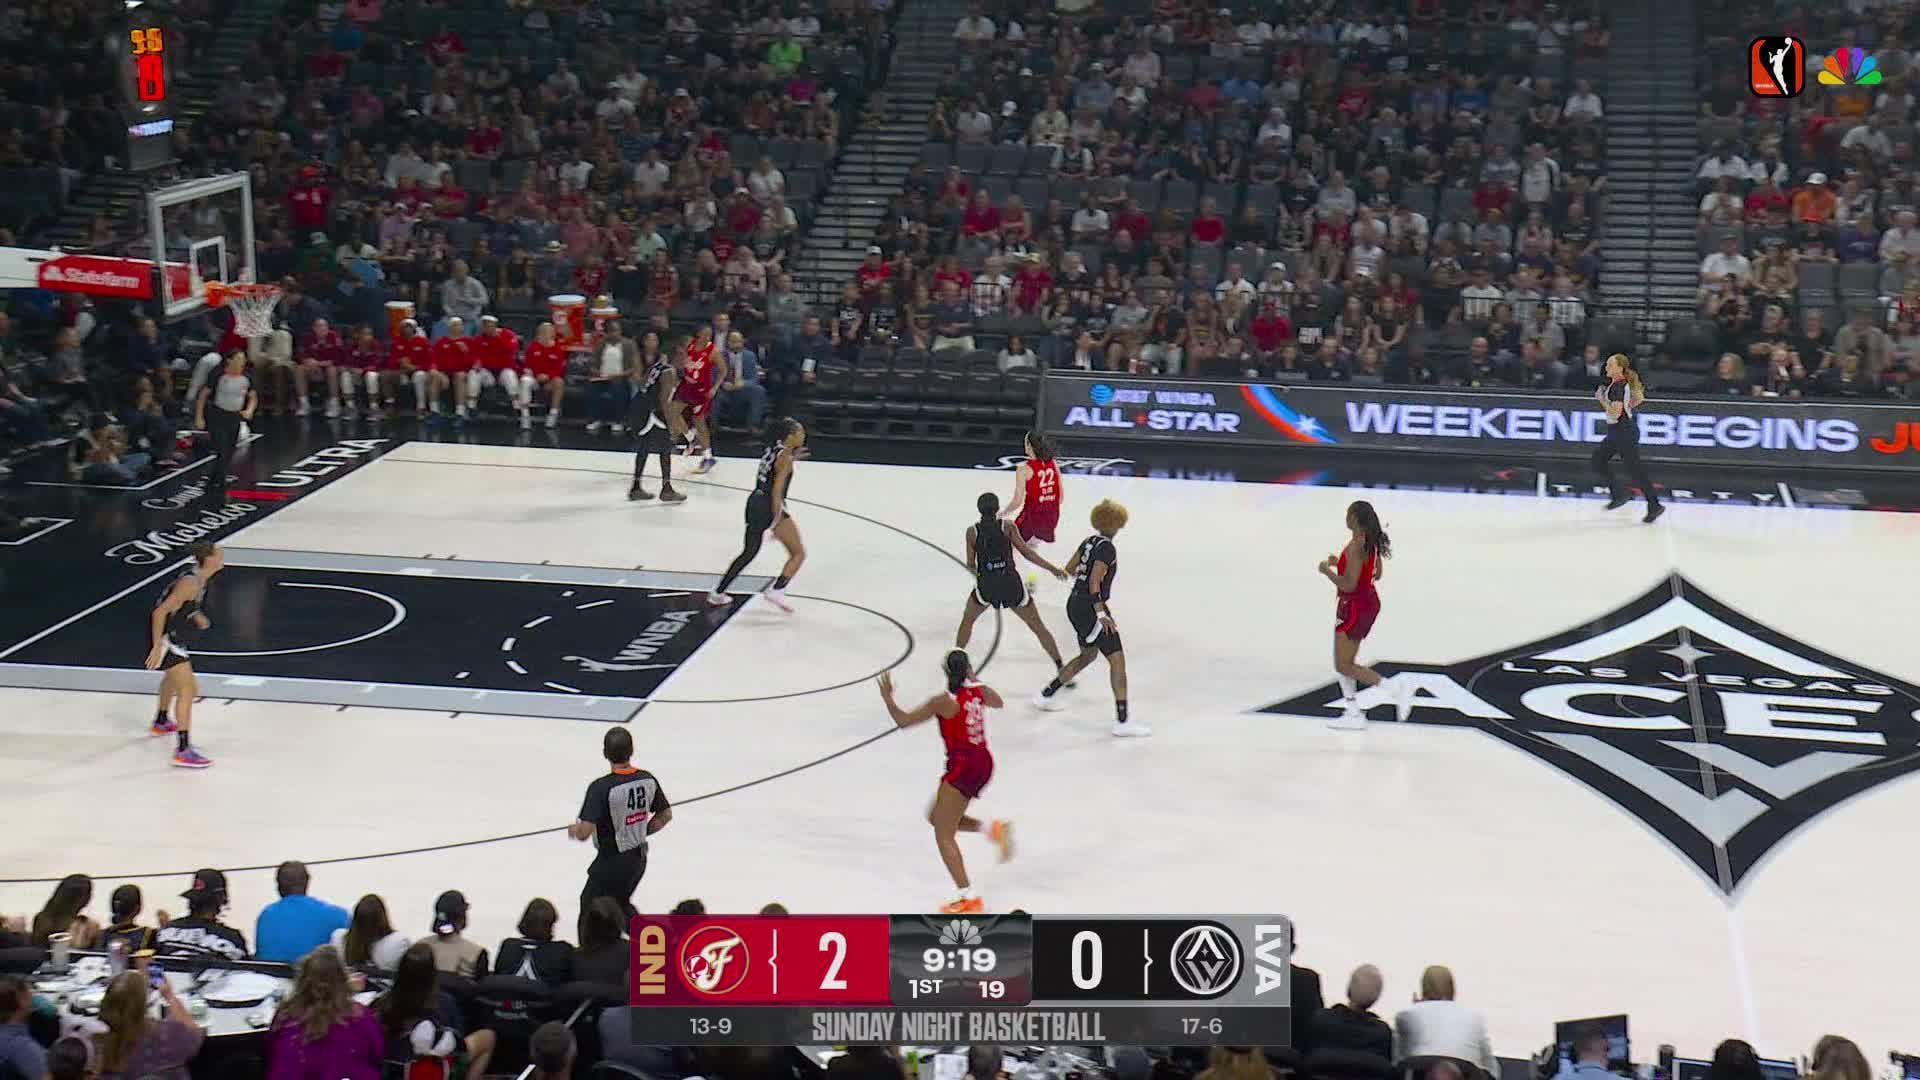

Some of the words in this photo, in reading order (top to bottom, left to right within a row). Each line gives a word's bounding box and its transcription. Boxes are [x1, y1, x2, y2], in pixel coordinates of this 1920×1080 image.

[1345, 401, 1608, 442] WEEKEND
[1636, 413, 1859, 452] BEGINS
[256, 438, 391, 488] ULTRA
[1037, 467, 1056, 488] 22
[1552, 483, 1775, 501] THRTY
[104, 500, 258, 565] Michelob
[611, 610, 700, 661] WNBA
[1502, 661, 1629, 679] LAS
[1660, 670, 1895, 696] VEGAS
[1322, 671, 1920, 746] ACE
[627, 785, 646, 810] 42
